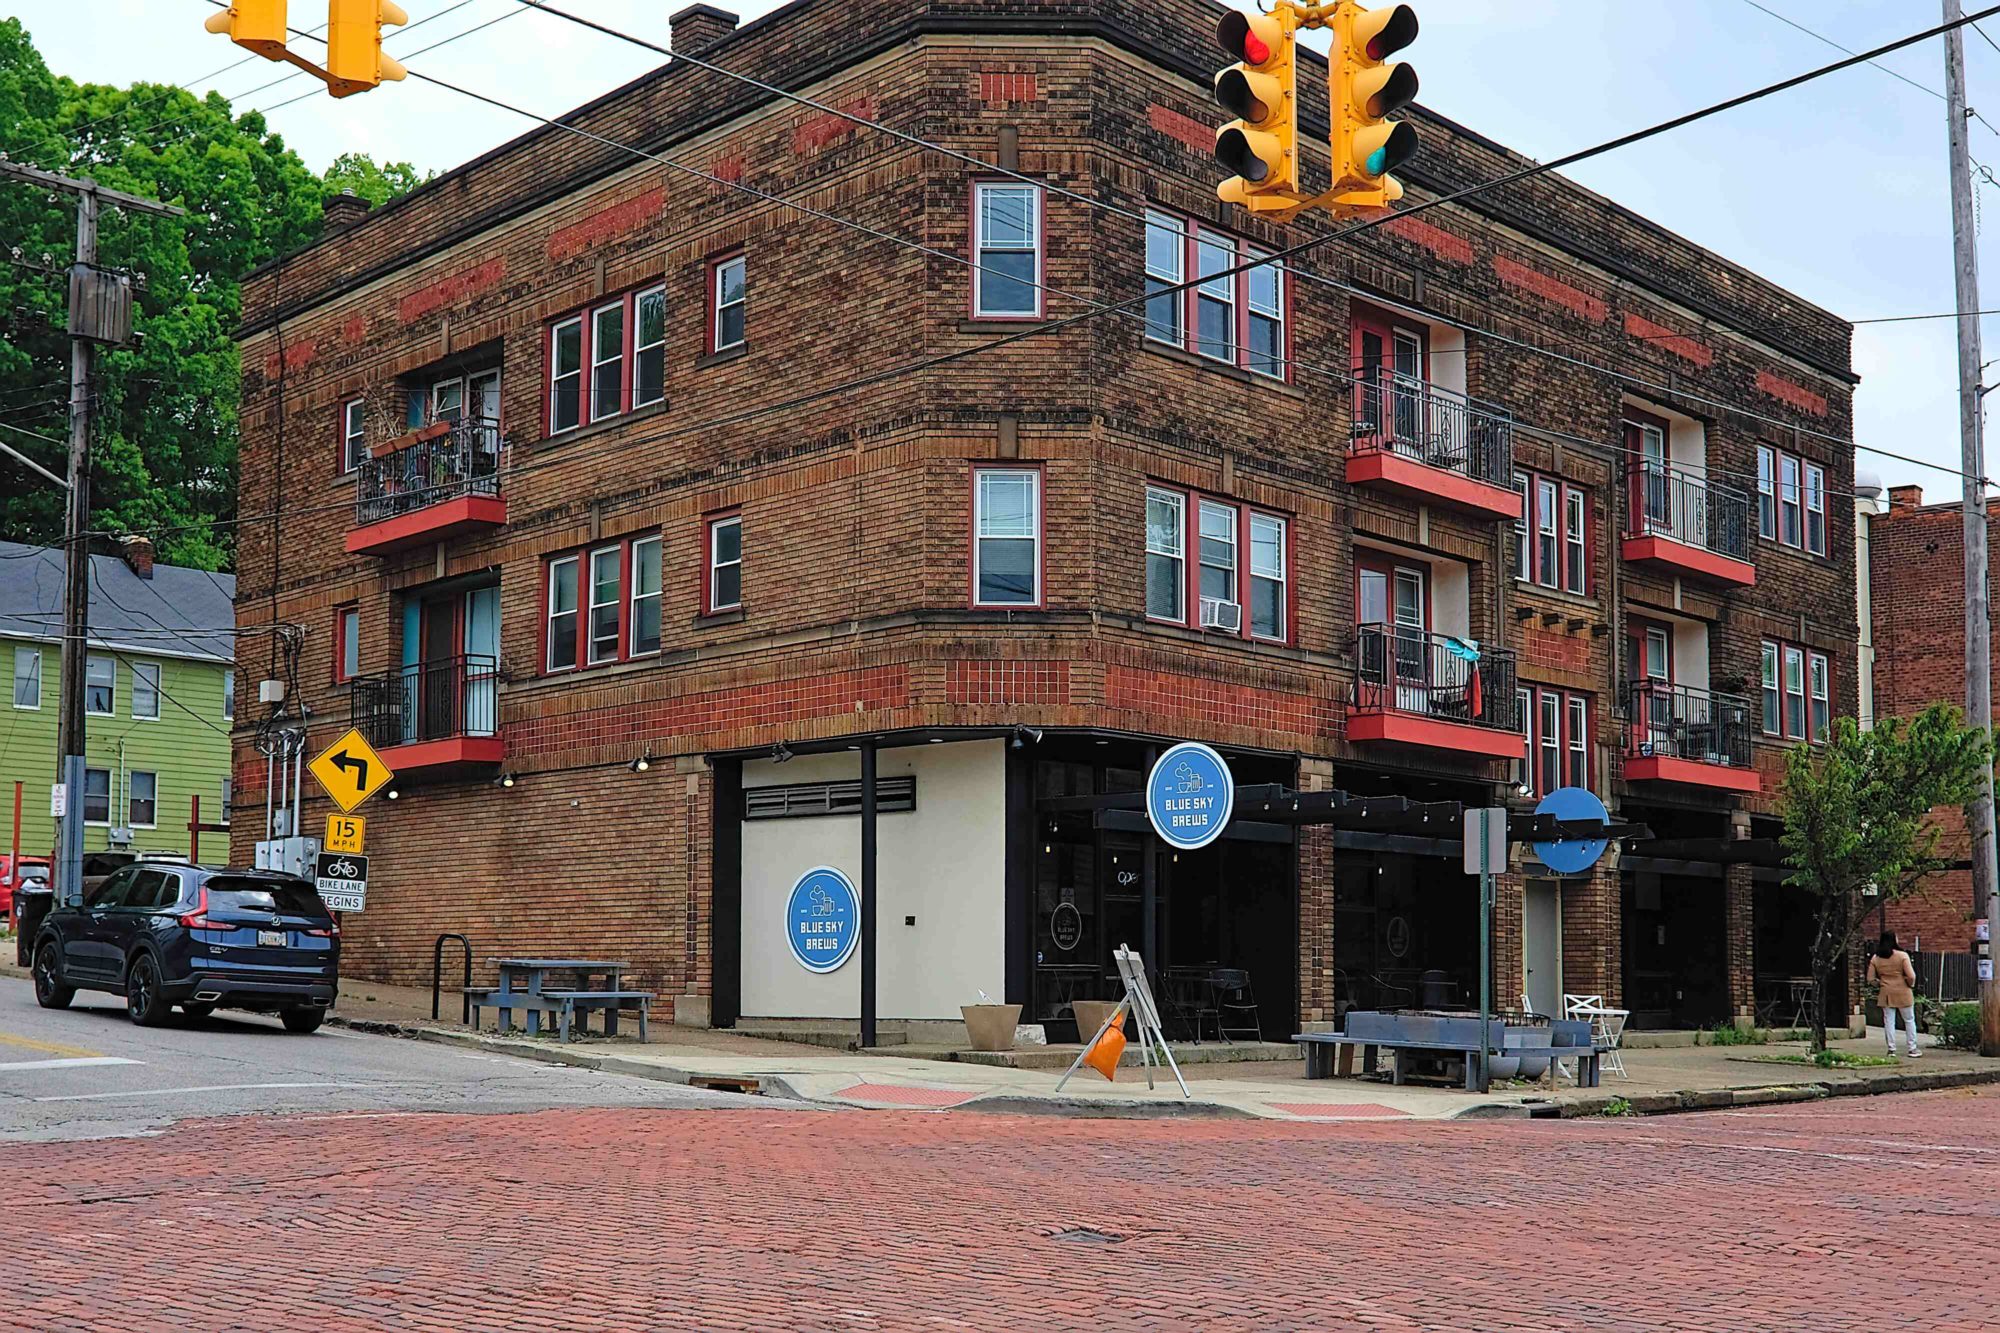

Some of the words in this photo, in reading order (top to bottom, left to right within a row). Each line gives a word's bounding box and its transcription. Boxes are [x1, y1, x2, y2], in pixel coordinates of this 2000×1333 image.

[1165, 798, 1191, 811] BLUE
[1193, 796, 1214, 809] SKY
[1172, 814, 1208, 827] BREWS
[336, 821, 355, 838] 15
[333, 839, 355, 848] MPH
[319, 879, 339, 890] BIKE
[340, 881, 362, 892] LANE
[800, 921, 824, 934] BLUE
[825, 920, 844, 933] SKY
[806, 938, 838, 950] BREWS
